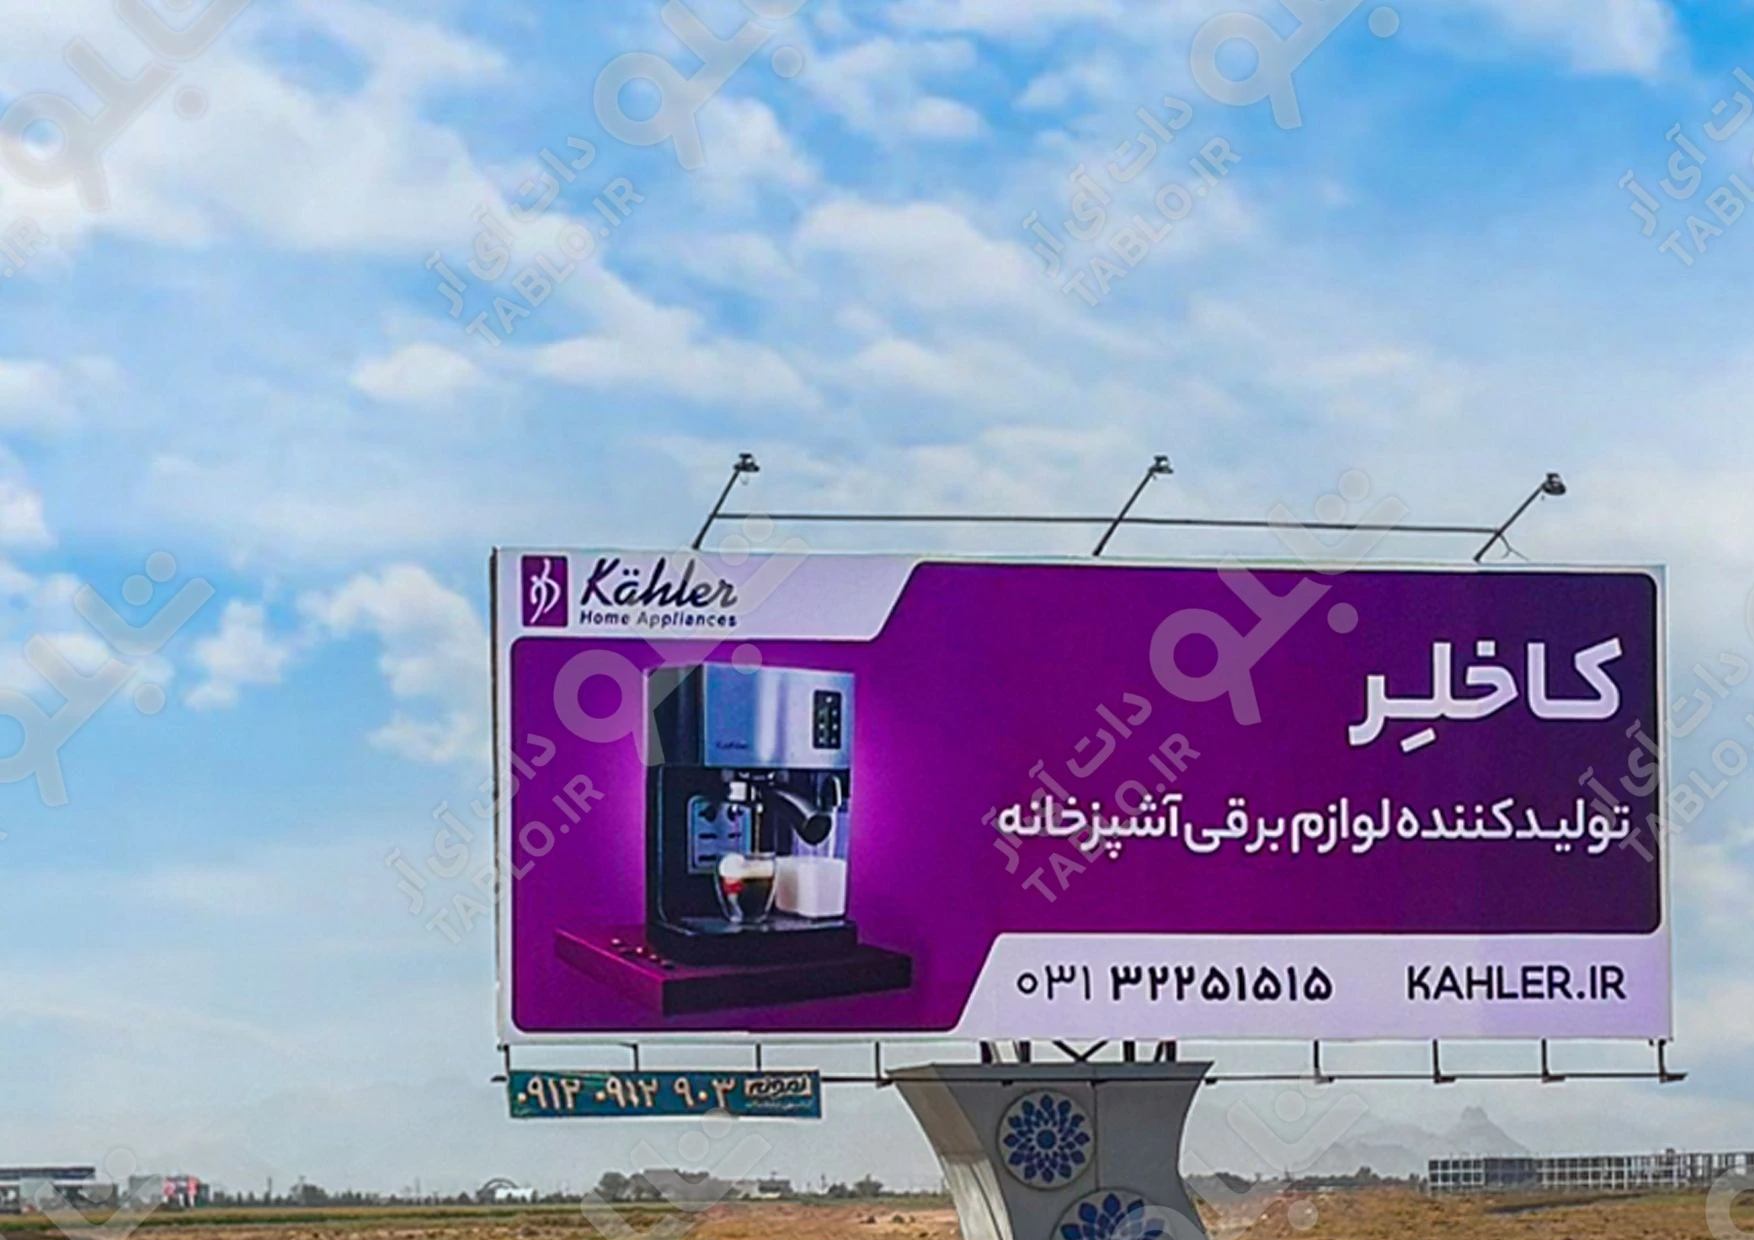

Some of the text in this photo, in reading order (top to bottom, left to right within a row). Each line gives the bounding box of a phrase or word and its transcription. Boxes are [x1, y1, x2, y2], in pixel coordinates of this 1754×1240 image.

[580, 557, 739, 609] Kähler
[579, 610, 738, 628] Home Appliances
[998, 793, 1183, 860] آشپزخانه
[1183, 797, 1285, 853] برقی
[1290, 797, 1391, 854] لوازم
[1016, 964, 1334, 1001] ۰۳۱ ۳۲۲۵۱۵۱۵
[1407, 964, 1627, 1000] KAHLER.IR
